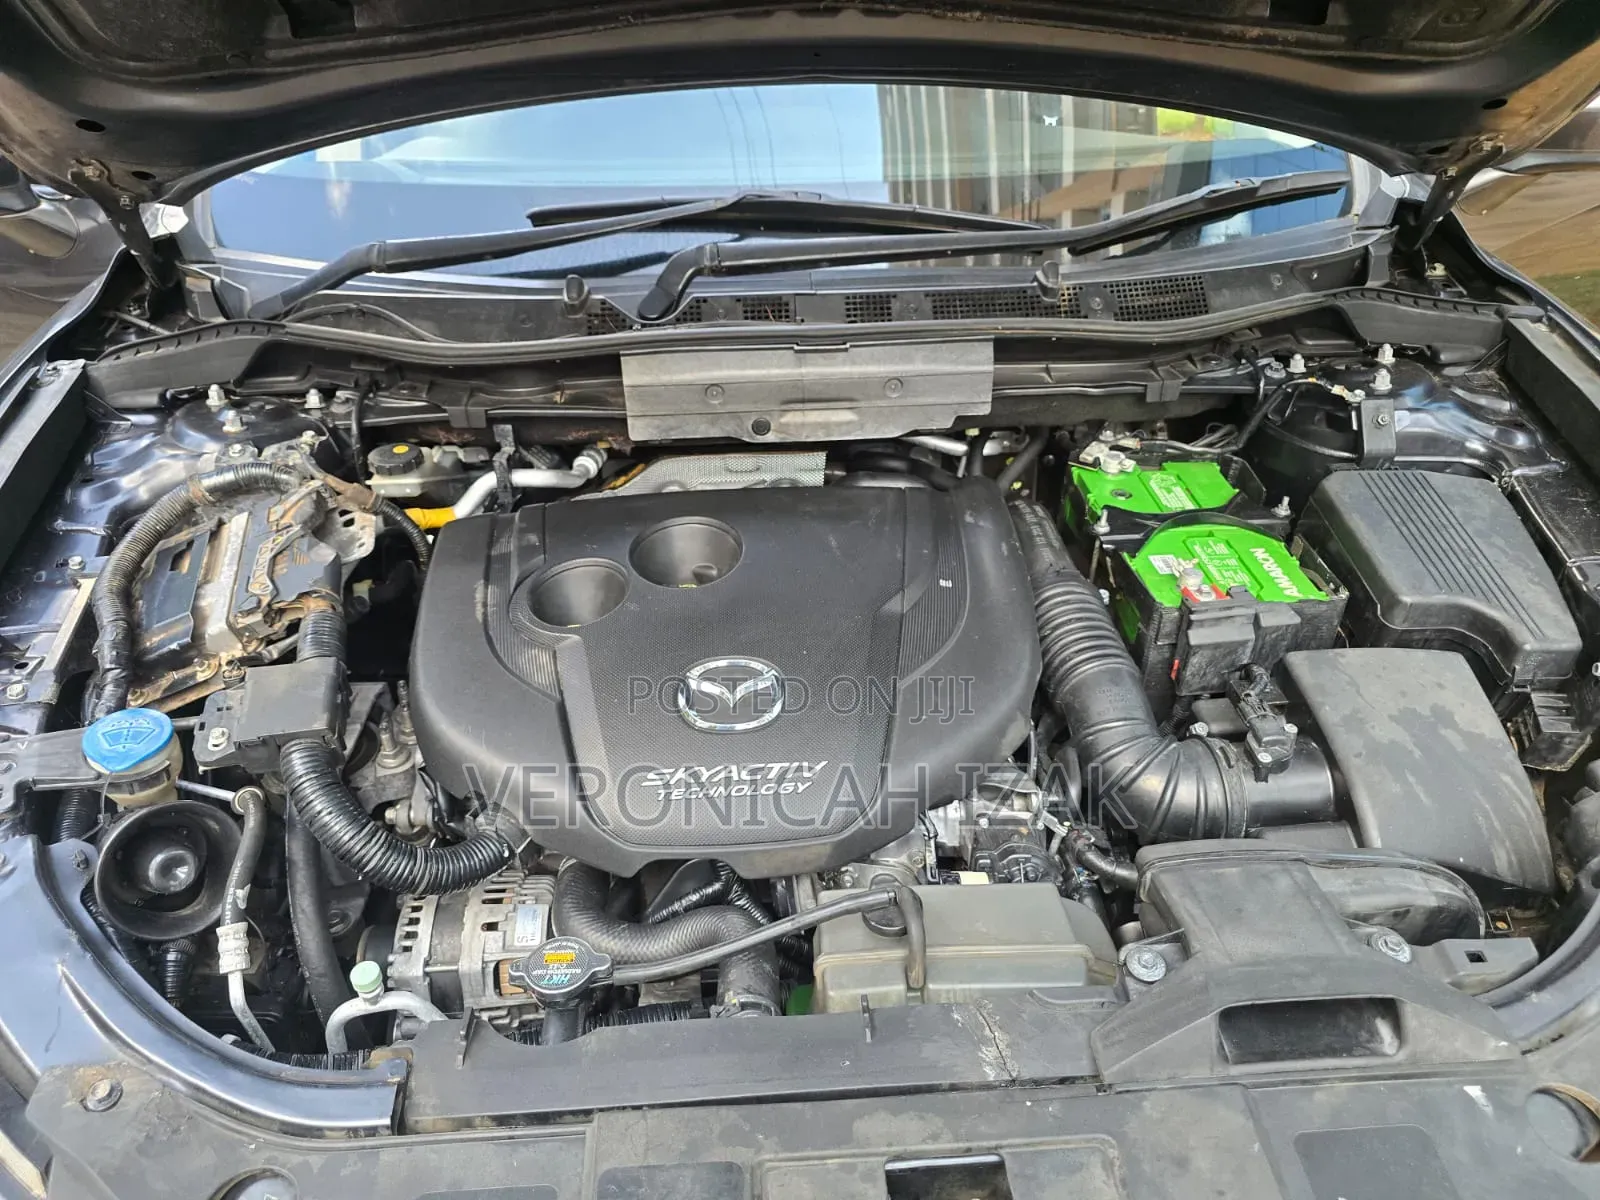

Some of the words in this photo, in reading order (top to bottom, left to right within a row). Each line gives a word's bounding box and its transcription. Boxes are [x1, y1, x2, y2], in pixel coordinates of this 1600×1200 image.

[1249, 548, 1303, 597] AMARON
[641, 760, 829, 786] SKYACTIV
[657, 781, 813, 801] TECHNOLOGY
[540, 973, 571, 985] HKT
